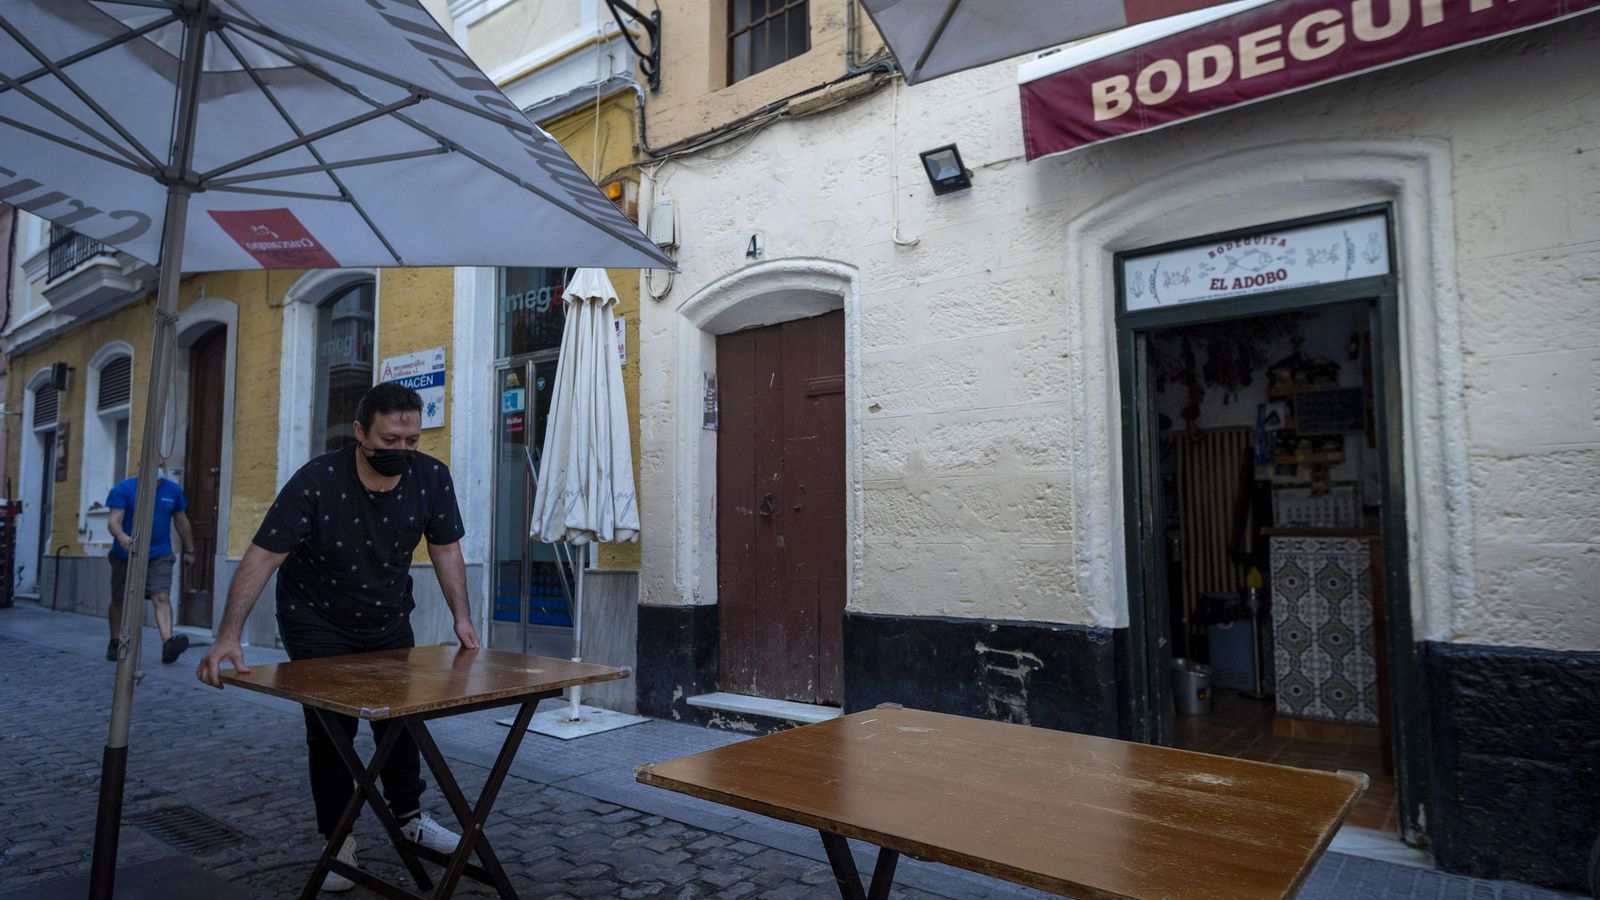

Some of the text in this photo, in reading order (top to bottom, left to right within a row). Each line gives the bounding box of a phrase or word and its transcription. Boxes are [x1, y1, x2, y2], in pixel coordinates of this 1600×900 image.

[1091, 0, 1518, 122] BODEGUI
[746, 234, 759, 259] 4
[1208, 236, 1287, 259] BODEGUITA
[1209, 268, 1288, 290] EL ADOBO
[393, 374, 434, 388] MACÉN
